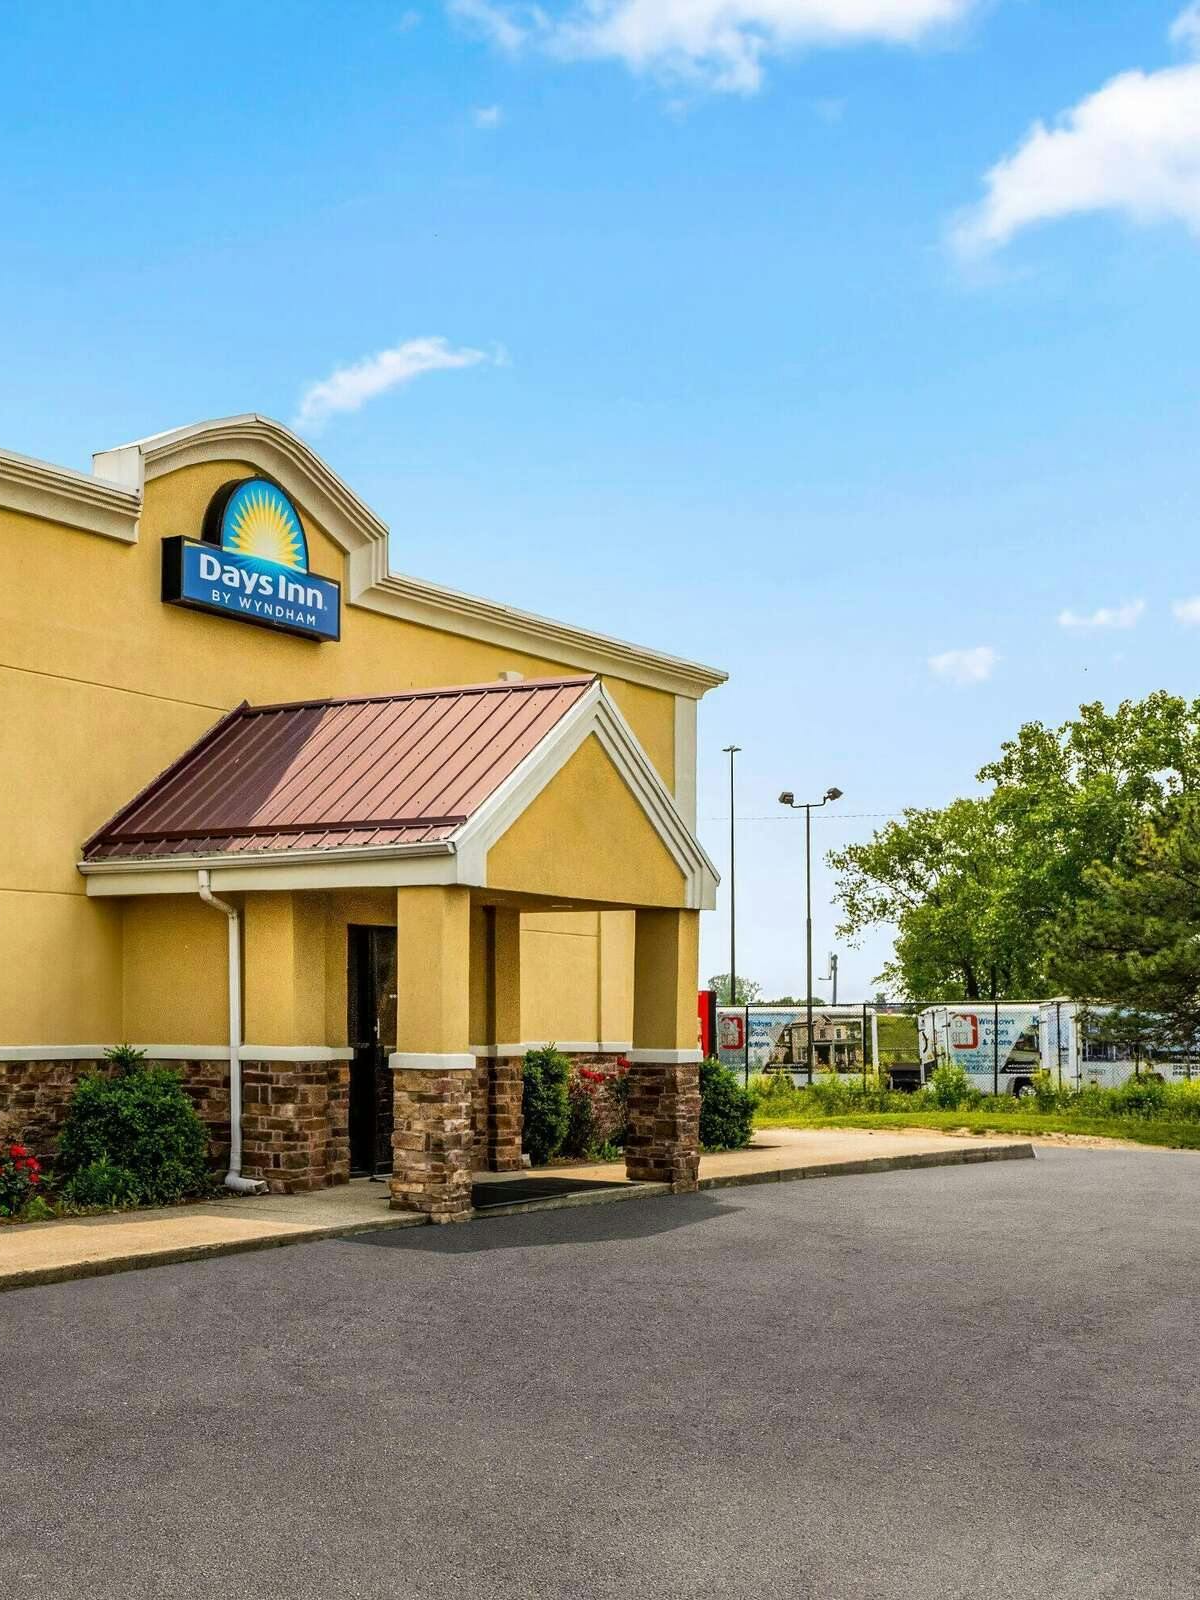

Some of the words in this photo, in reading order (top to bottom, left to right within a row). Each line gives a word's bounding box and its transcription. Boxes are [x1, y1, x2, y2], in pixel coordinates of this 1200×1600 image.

[200, 553, 274, 596] Days
[211, 589, 231, 604] BY
[239, 596, 317, 627] WYNDHAM
